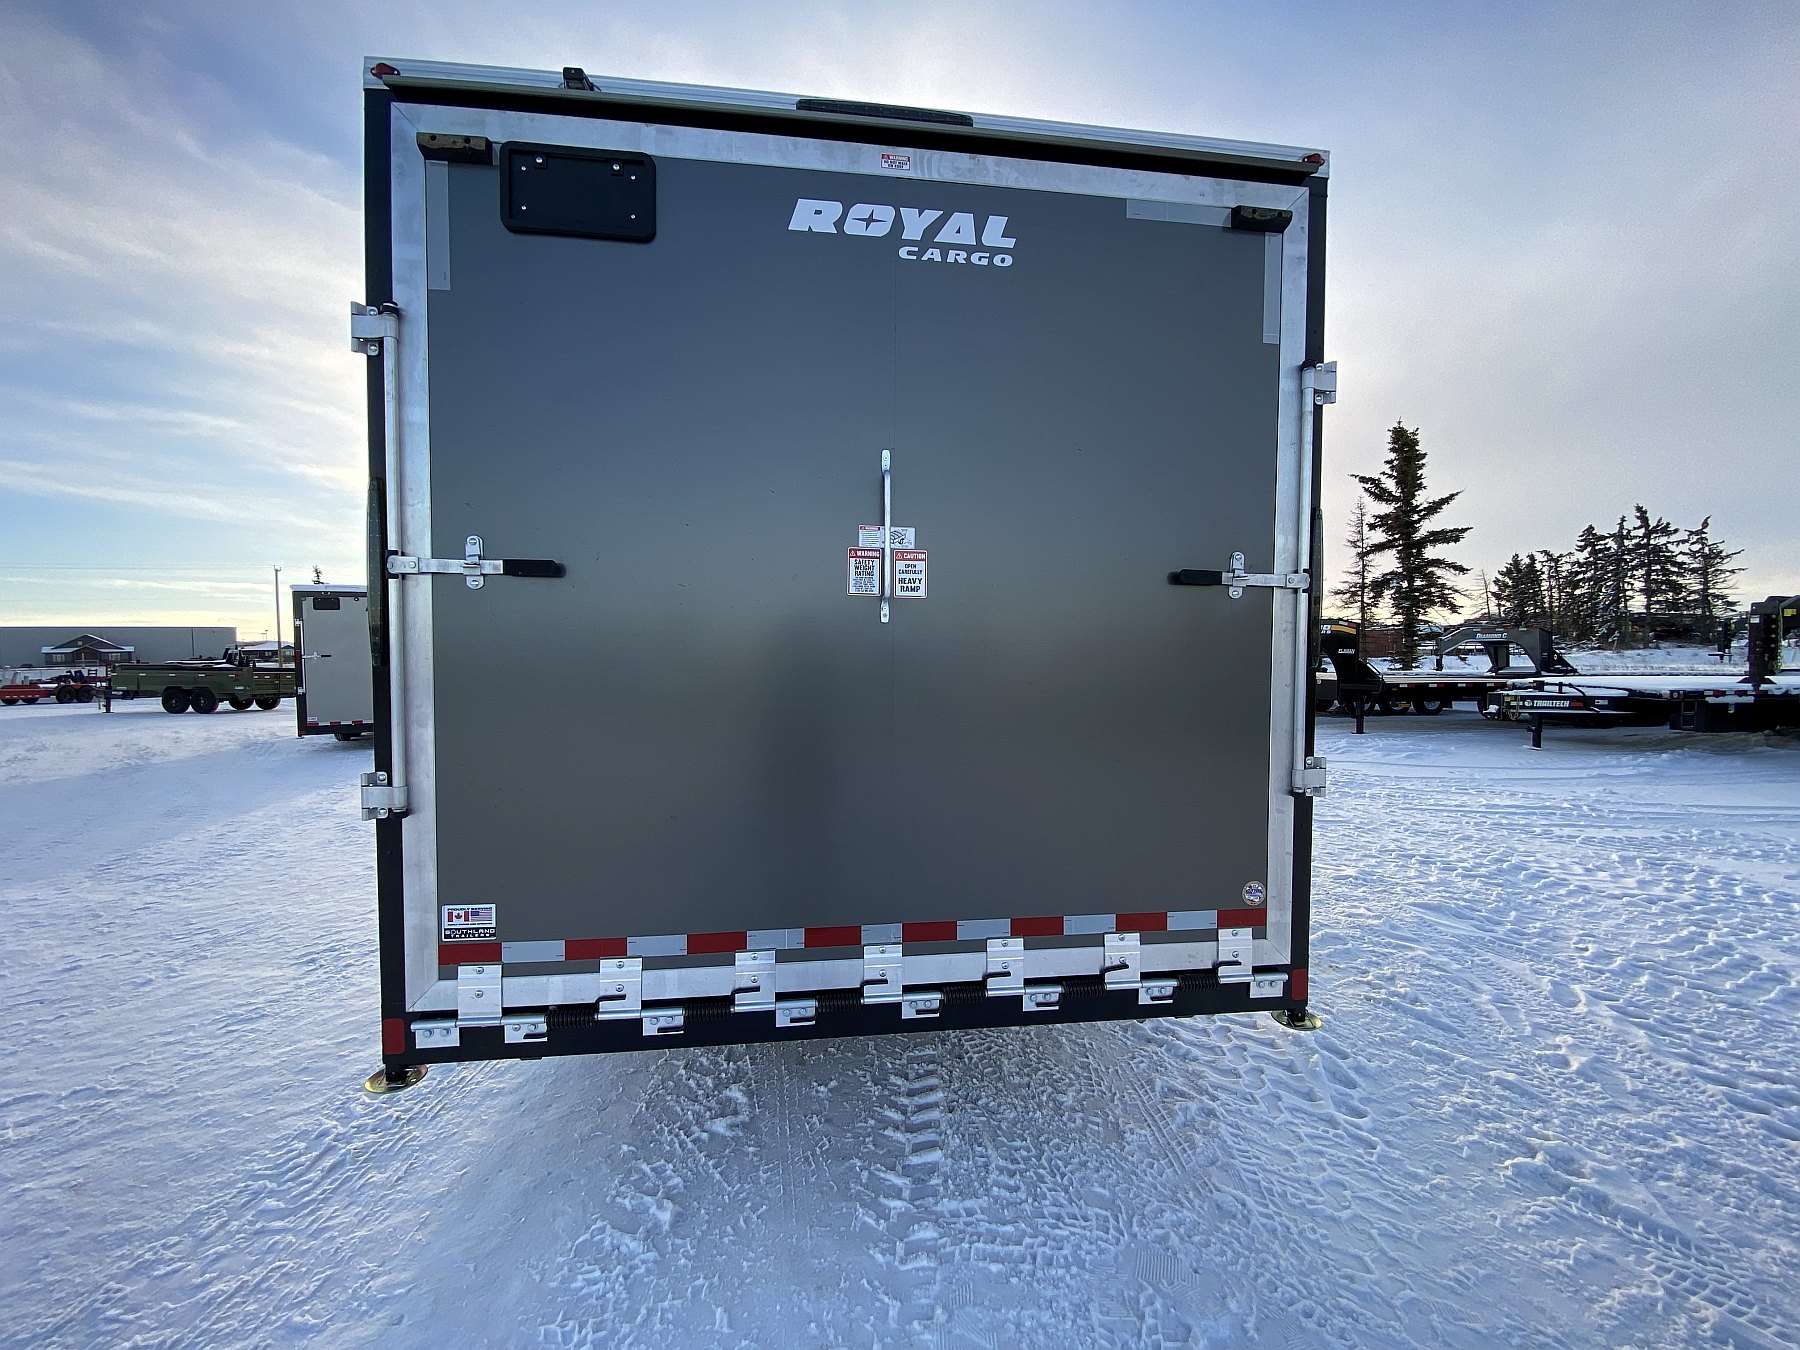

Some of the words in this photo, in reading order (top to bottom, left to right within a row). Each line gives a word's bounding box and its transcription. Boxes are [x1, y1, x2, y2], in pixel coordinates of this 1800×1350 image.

[788, 198, 1017, 248] ROYAL
[898, 246, 1013, 267] CARGO
[856, 550, 880, 558] WARNING
[903, 552, 926, 560] CAUTION
[898, 577, 923, 585] HEAVY
[900, 585, 921, 593] RAMP
